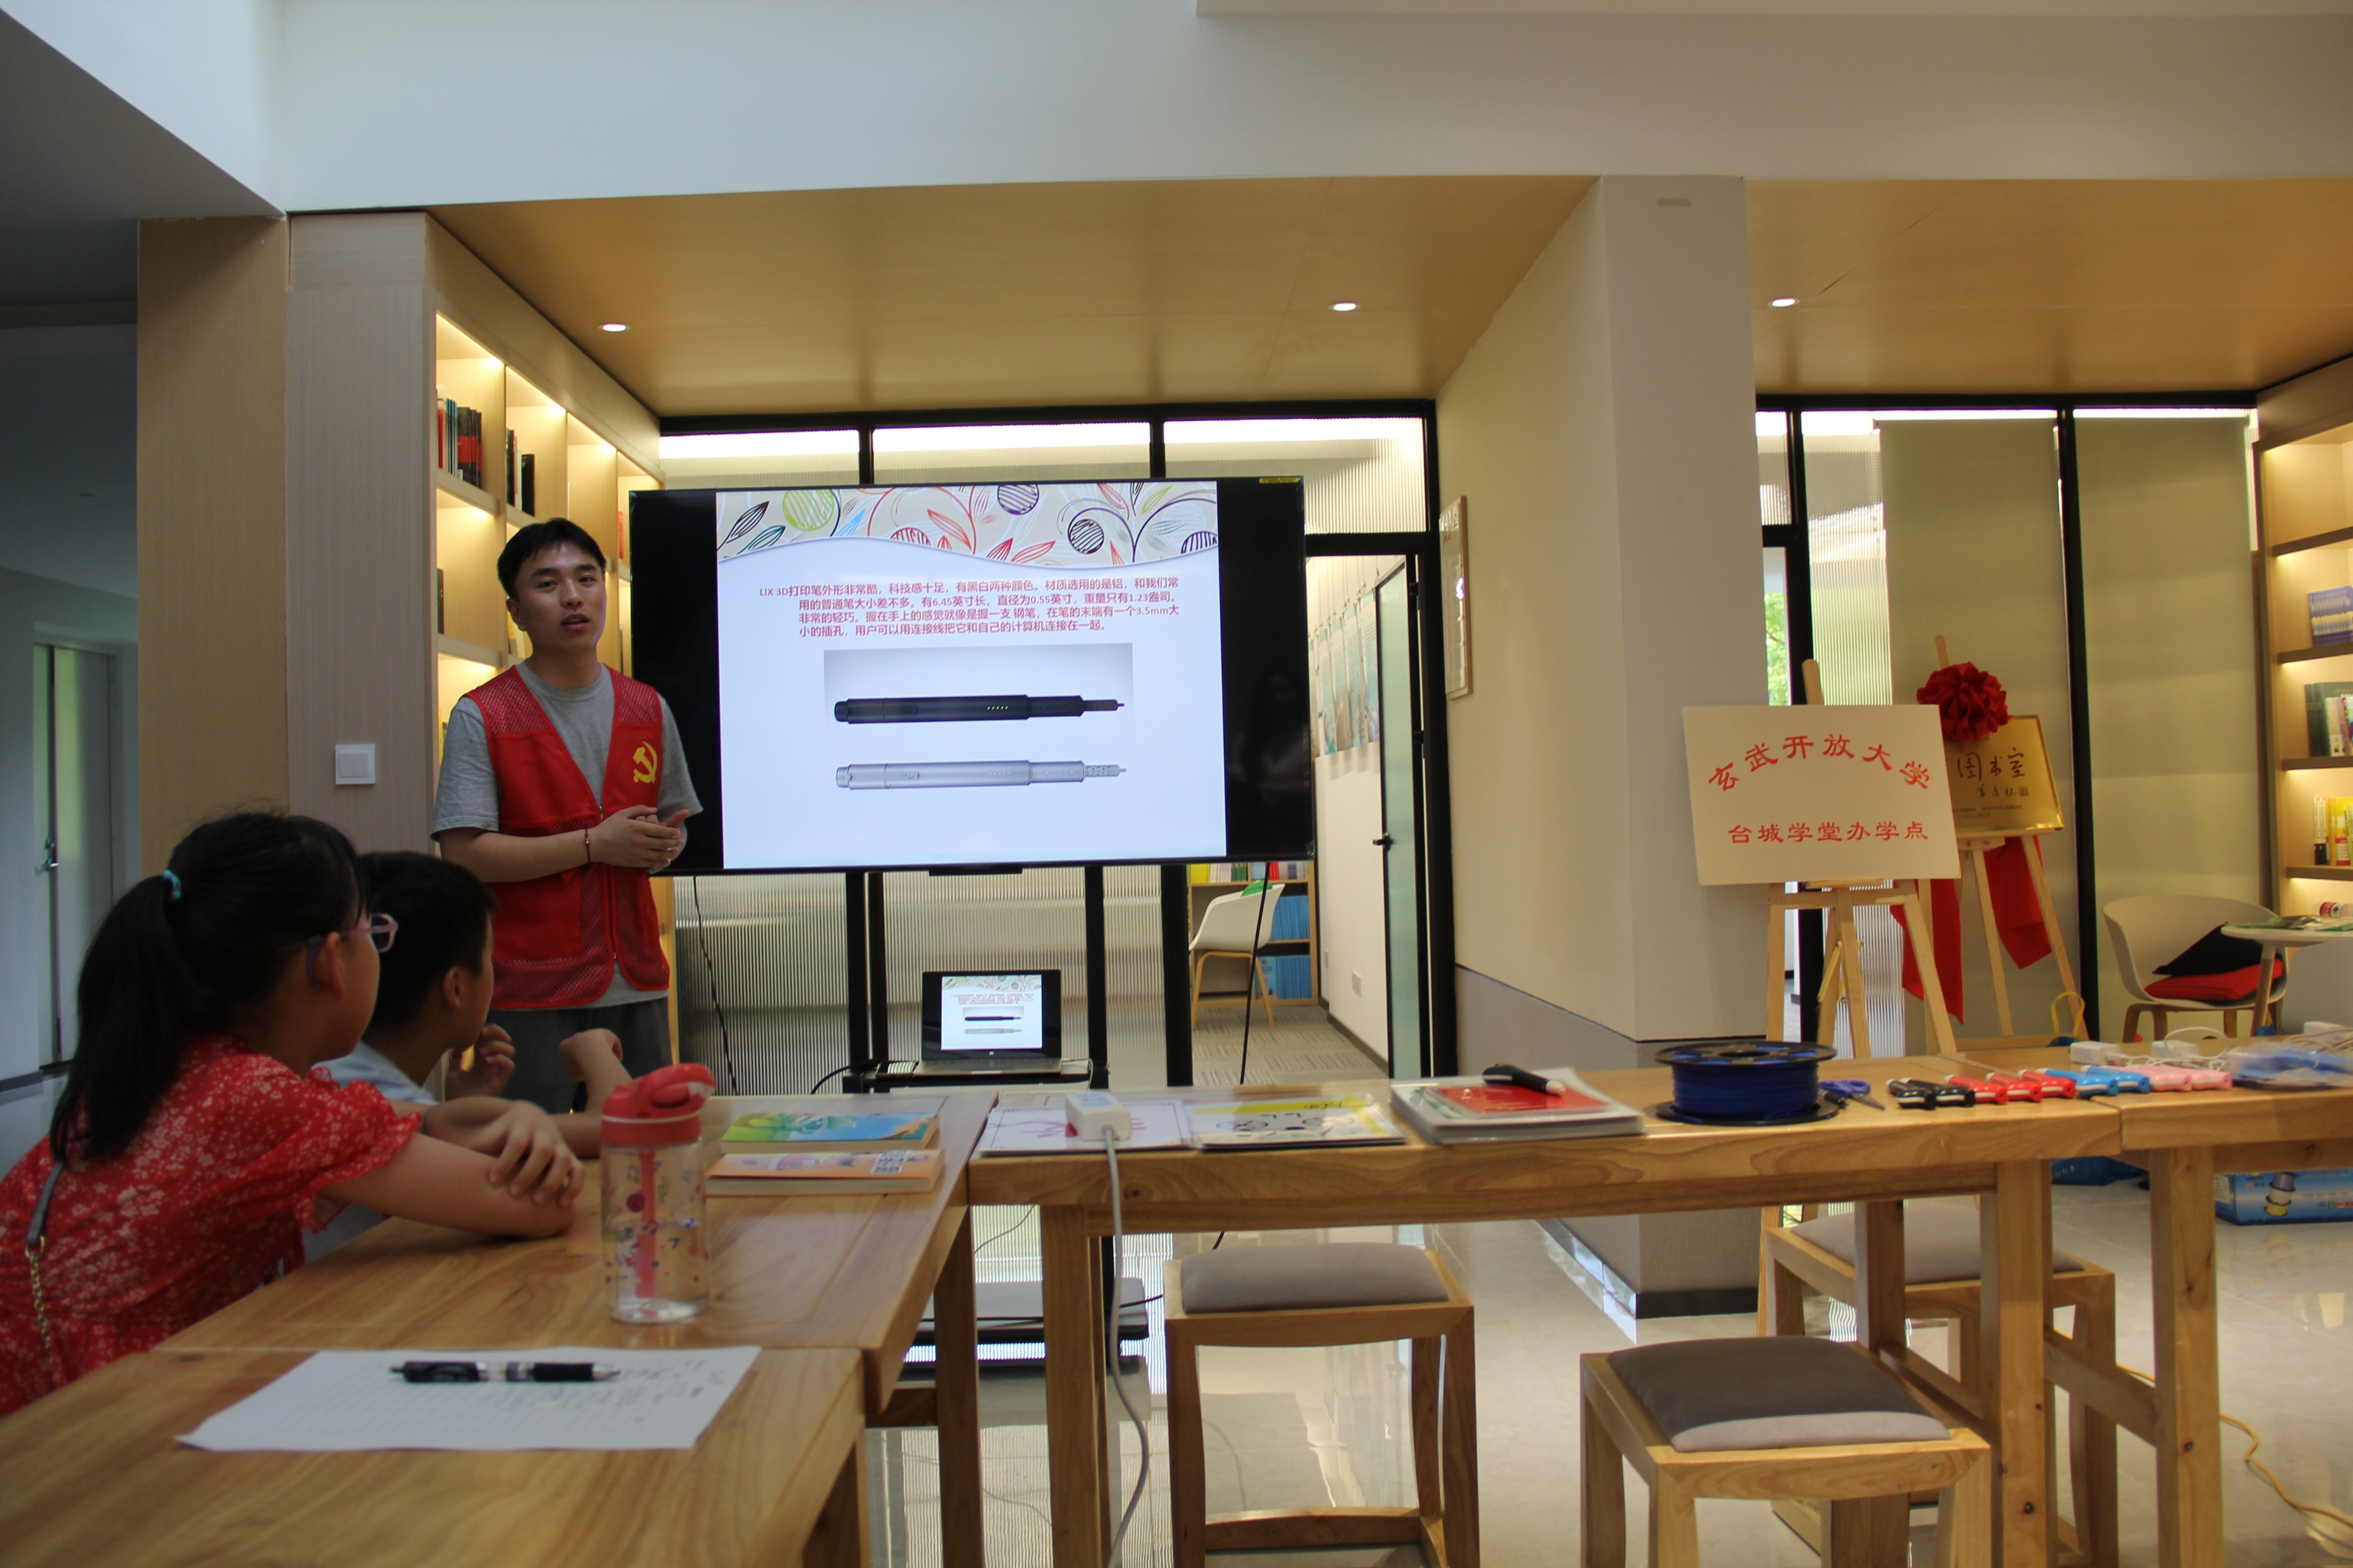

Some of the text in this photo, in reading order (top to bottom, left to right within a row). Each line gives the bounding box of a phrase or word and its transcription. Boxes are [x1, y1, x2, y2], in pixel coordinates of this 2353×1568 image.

[760, 587, 773, 597] LIX
[1708, 733, 1930, 791] 玄武开放大学
[1728, 820, 1929, 844] 台城学堂办学点
